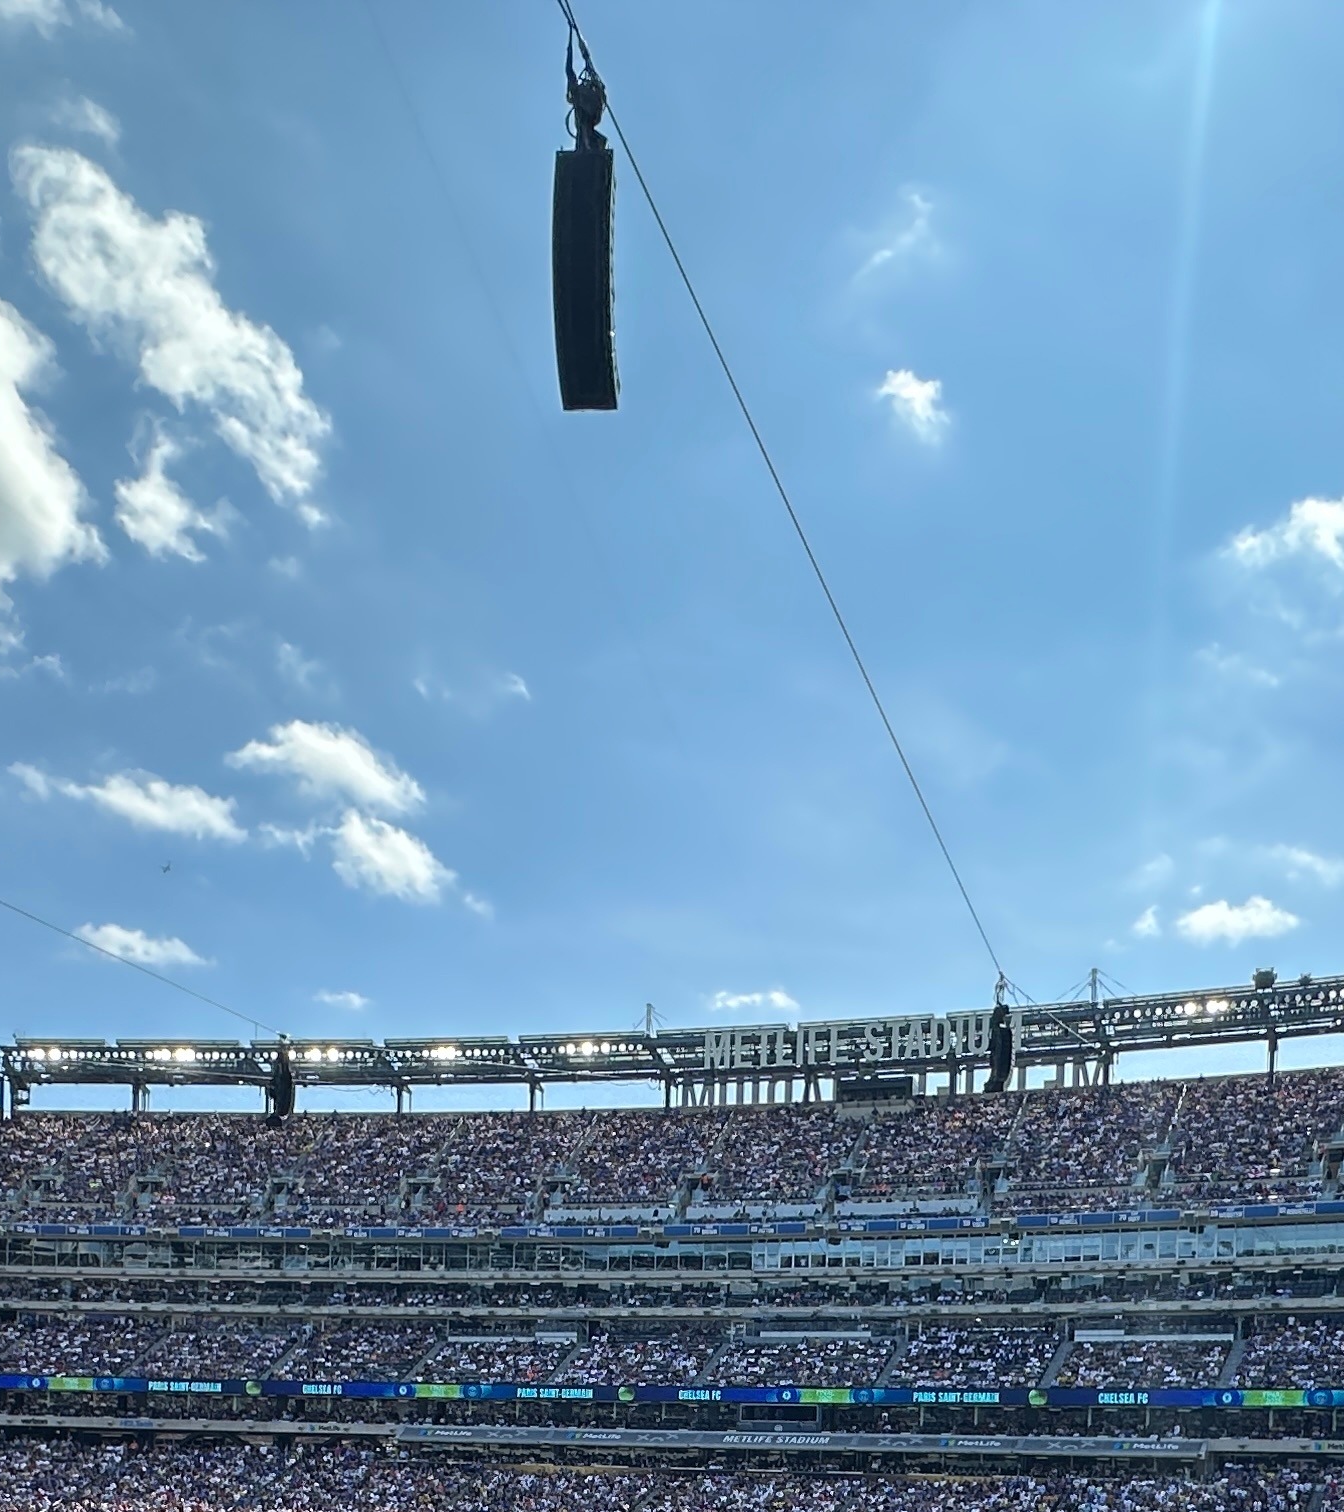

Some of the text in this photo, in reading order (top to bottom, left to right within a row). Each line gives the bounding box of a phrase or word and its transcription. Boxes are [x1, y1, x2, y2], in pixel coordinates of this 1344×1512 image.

[703, 1024, 850, 1069] METLIFE
[1098, 1392, 1149, 1404] CHELSEA FC
[434, 1429, 473, 1437] MetLife
[722, 1435, 831, 1444] METLIFE STADIUM
[957, 1439, 1002, 1447] MetLife
[1132, 1442, 1180, 1450] MetLife
